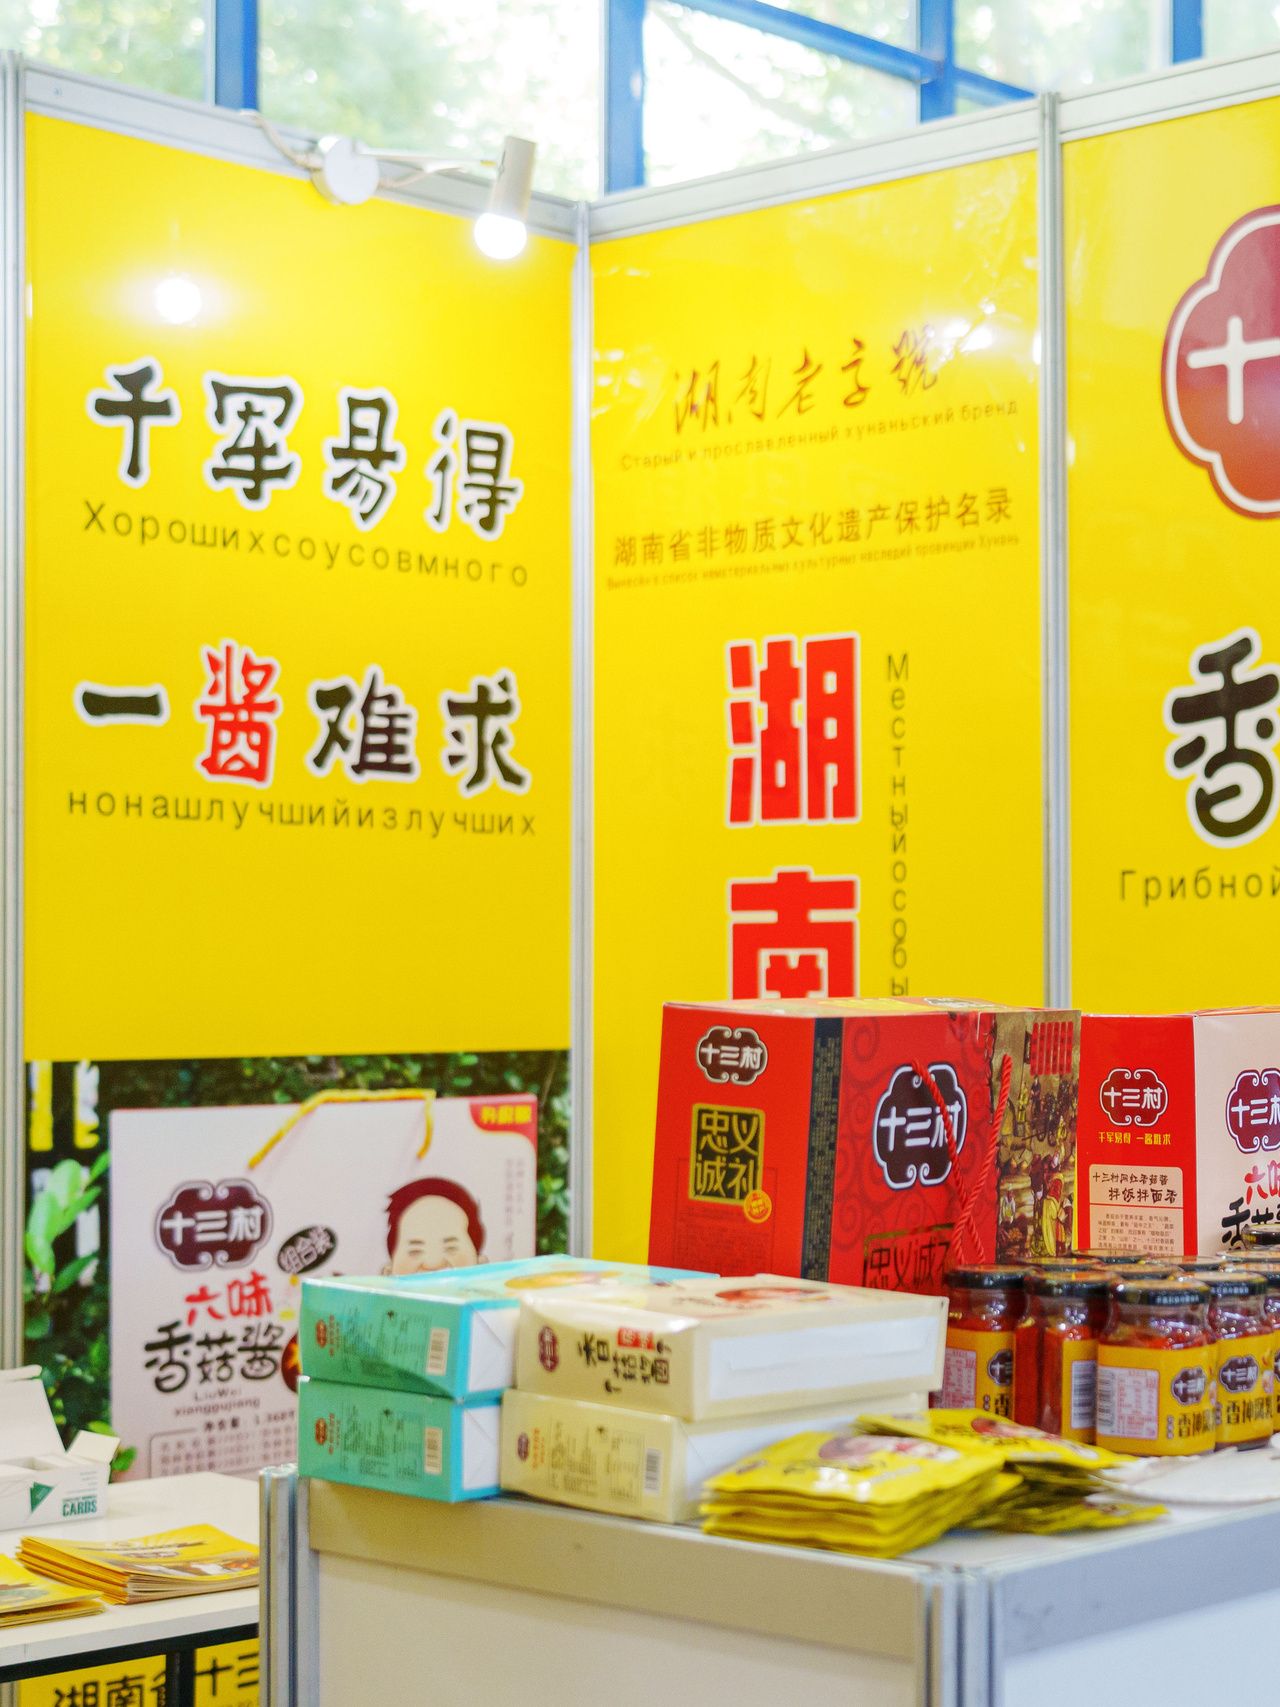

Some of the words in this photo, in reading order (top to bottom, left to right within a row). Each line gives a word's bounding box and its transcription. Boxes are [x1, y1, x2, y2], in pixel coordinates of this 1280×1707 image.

[620, 448, 683, 471] Старый
[703, 425, 839, 460] прославленный
[845, 408, 955, 441] хунаньский
[960, 400, 1018, 421] бренд
[614, 487, 1013, 568] 湖南省非物质文化遗产保护名录
[82, 644, 526, 791] 一酱难求
[700, 1042, 764, 1070] 十三村
[1103, 1087, 1163, 1111] 十三村
[879, 1101, 962, 1152] 十三村
[1108, 1187, 1178, 1205] 拌饭拌面香
[161, 1204, 265, 1246] 十三村
[184, 1269, 273, 1328] 六味
[144, 1320, 284, 1393] 香菇酱
[1222, 1365, 1258, 1384] 十三村
[62, 1499, 97, 1517] CARDS
